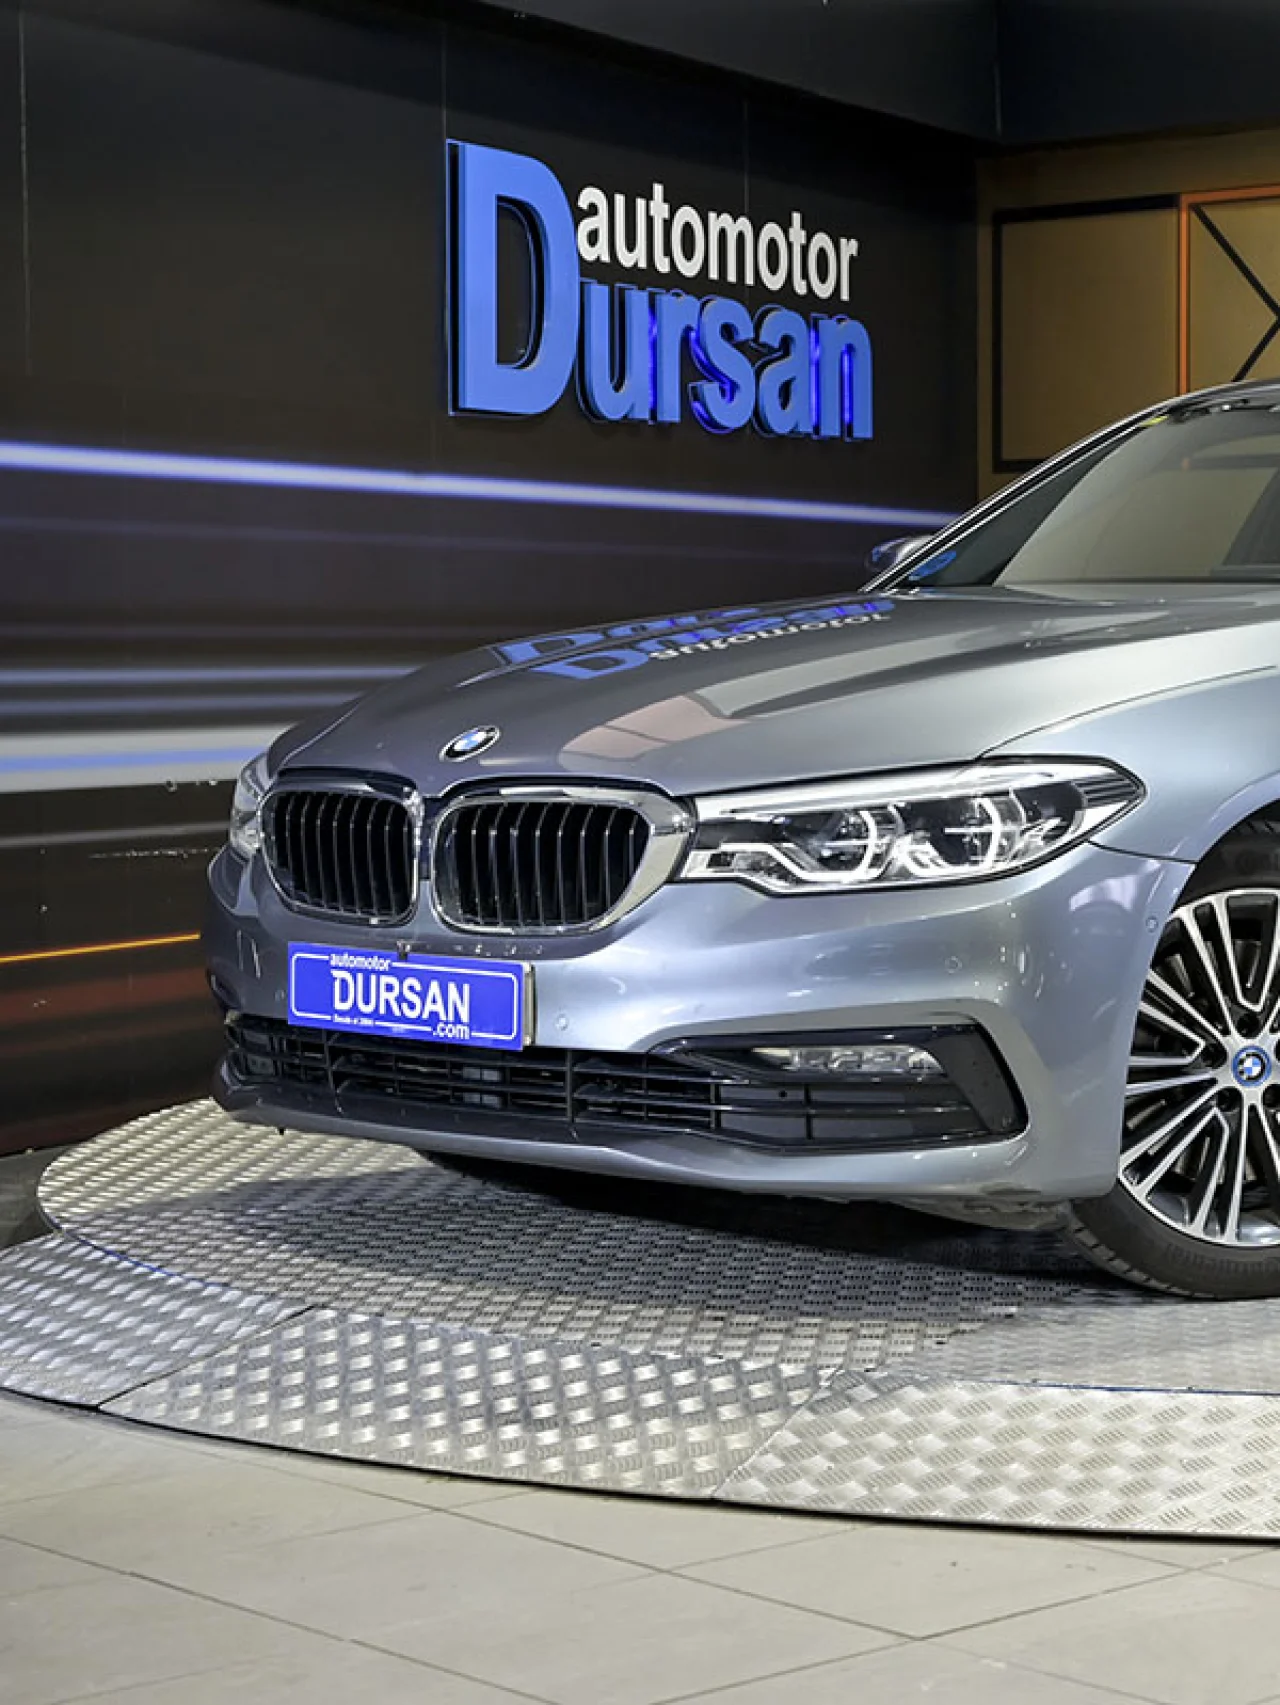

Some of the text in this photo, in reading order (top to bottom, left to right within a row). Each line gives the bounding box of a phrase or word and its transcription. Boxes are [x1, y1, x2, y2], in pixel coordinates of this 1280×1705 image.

[576, 181, 860, 302] automotor
[446, 138, 874, 443] Dursan
[329, 952, 392, 972] automotor
[330, 968, 471, 1024] DURSAN
[432, 1022, 471, 1040] .com
